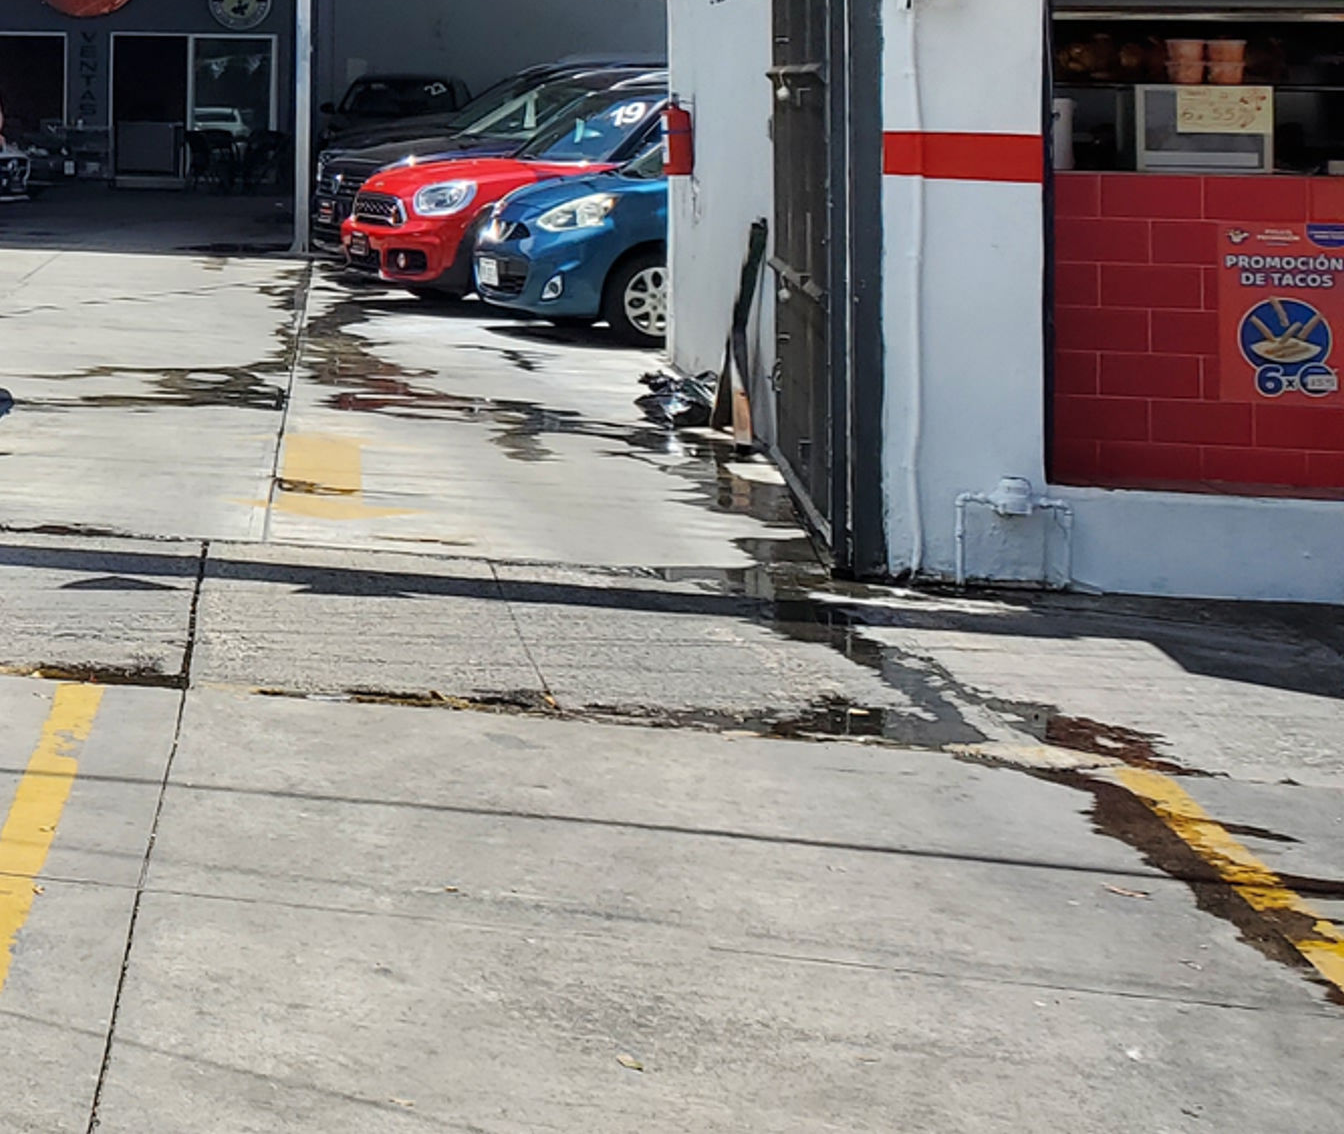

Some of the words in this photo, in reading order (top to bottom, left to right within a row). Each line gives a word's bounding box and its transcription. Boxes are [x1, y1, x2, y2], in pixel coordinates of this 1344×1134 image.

[79, 31, 99, 116] VENTAS
[610, 102, 645, 126] 19
[1225, 253, 1343, 271] PROMOCIÓN
[1240, 272, 1267, 285] DE
[1270, 272, 1334, 287] TACOS
[1255, 364, 1284, 397] 6
